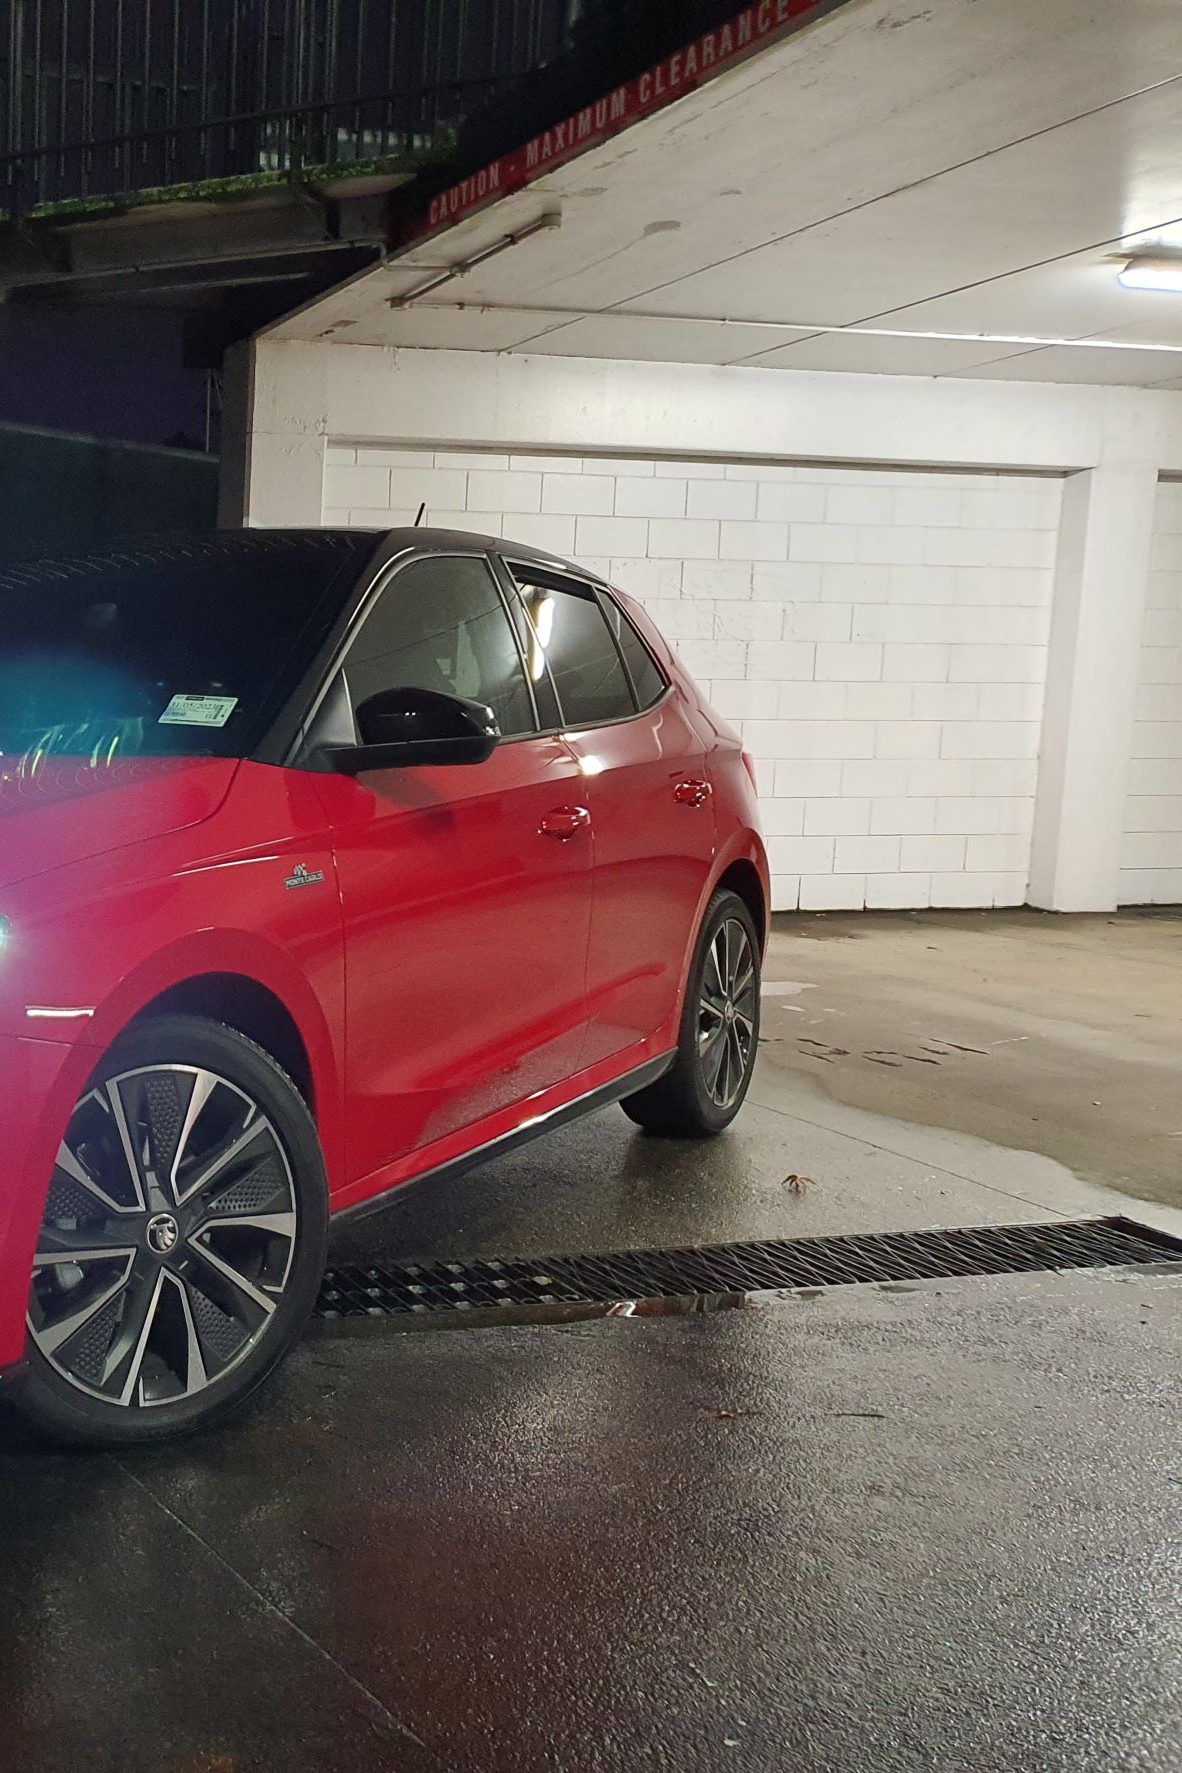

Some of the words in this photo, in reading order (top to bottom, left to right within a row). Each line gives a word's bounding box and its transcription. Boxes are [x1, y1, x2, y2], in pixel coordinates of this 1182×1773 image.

[429, 161, 500, 225] CAUTION
[526, 87, 626, 169] MAXIMUM
[639, 0, 789, 104] CLEARANCE
